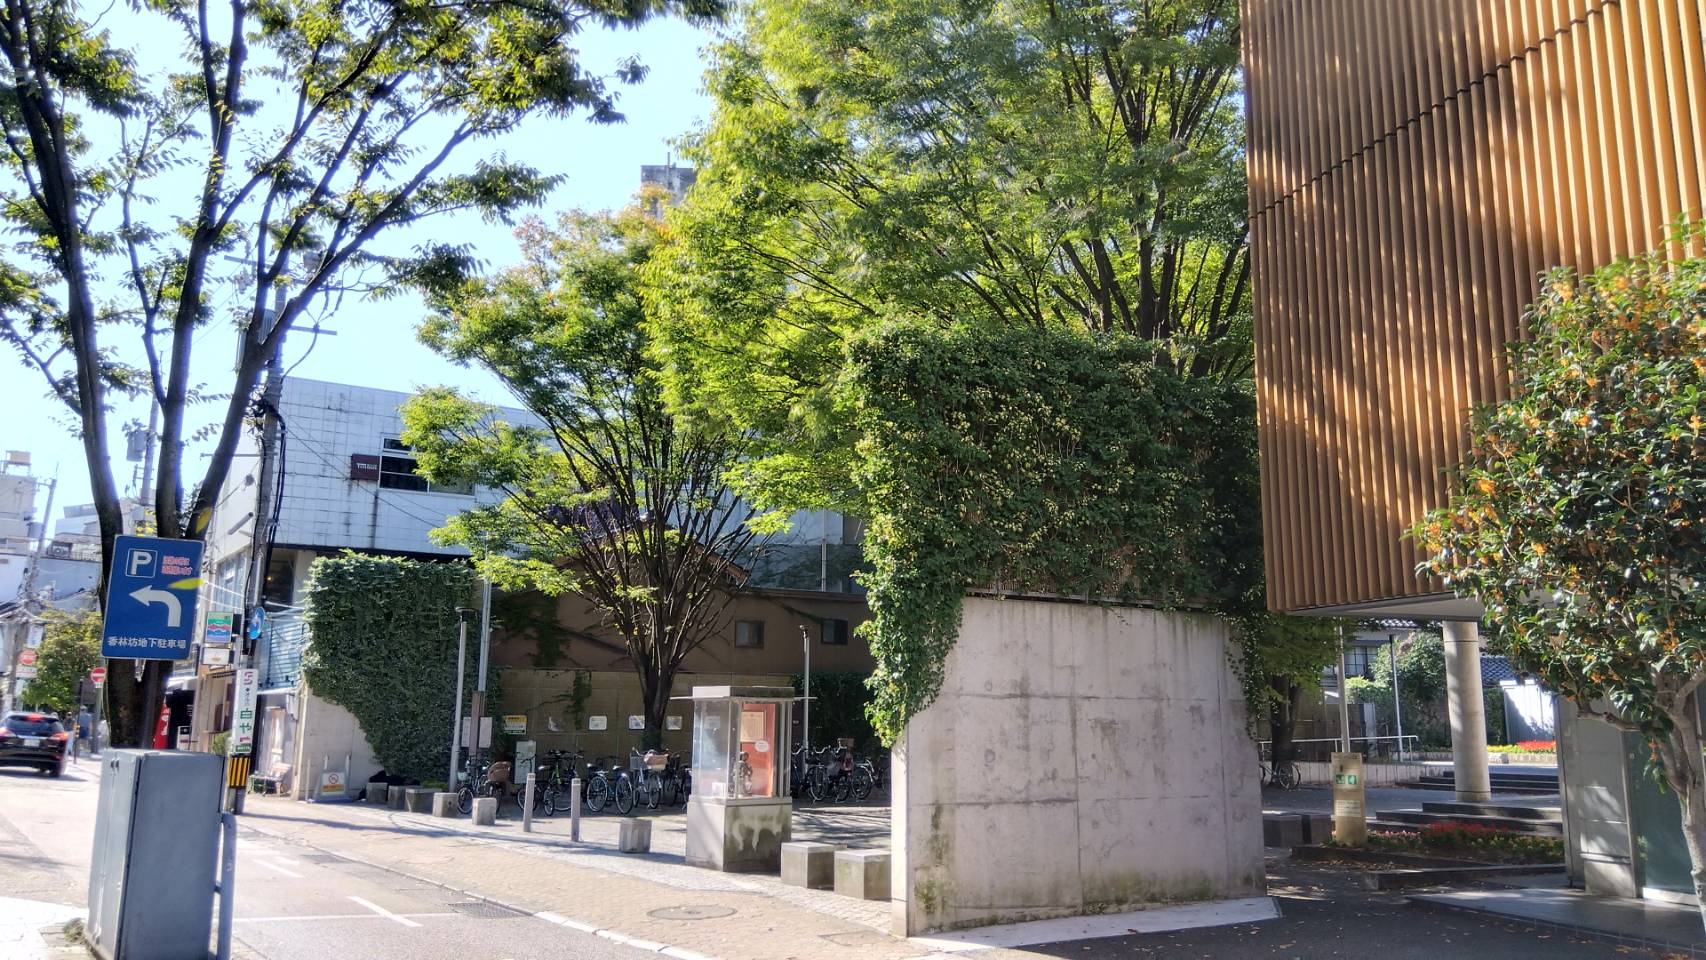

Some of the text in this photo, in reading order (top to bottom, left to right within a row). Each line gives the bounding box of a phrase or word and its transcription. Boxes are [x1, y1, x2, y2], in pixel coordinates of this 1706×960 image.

[131, 551, 153, 574] P
[108, 636, 187, 648] 香林坊地下駐車場
